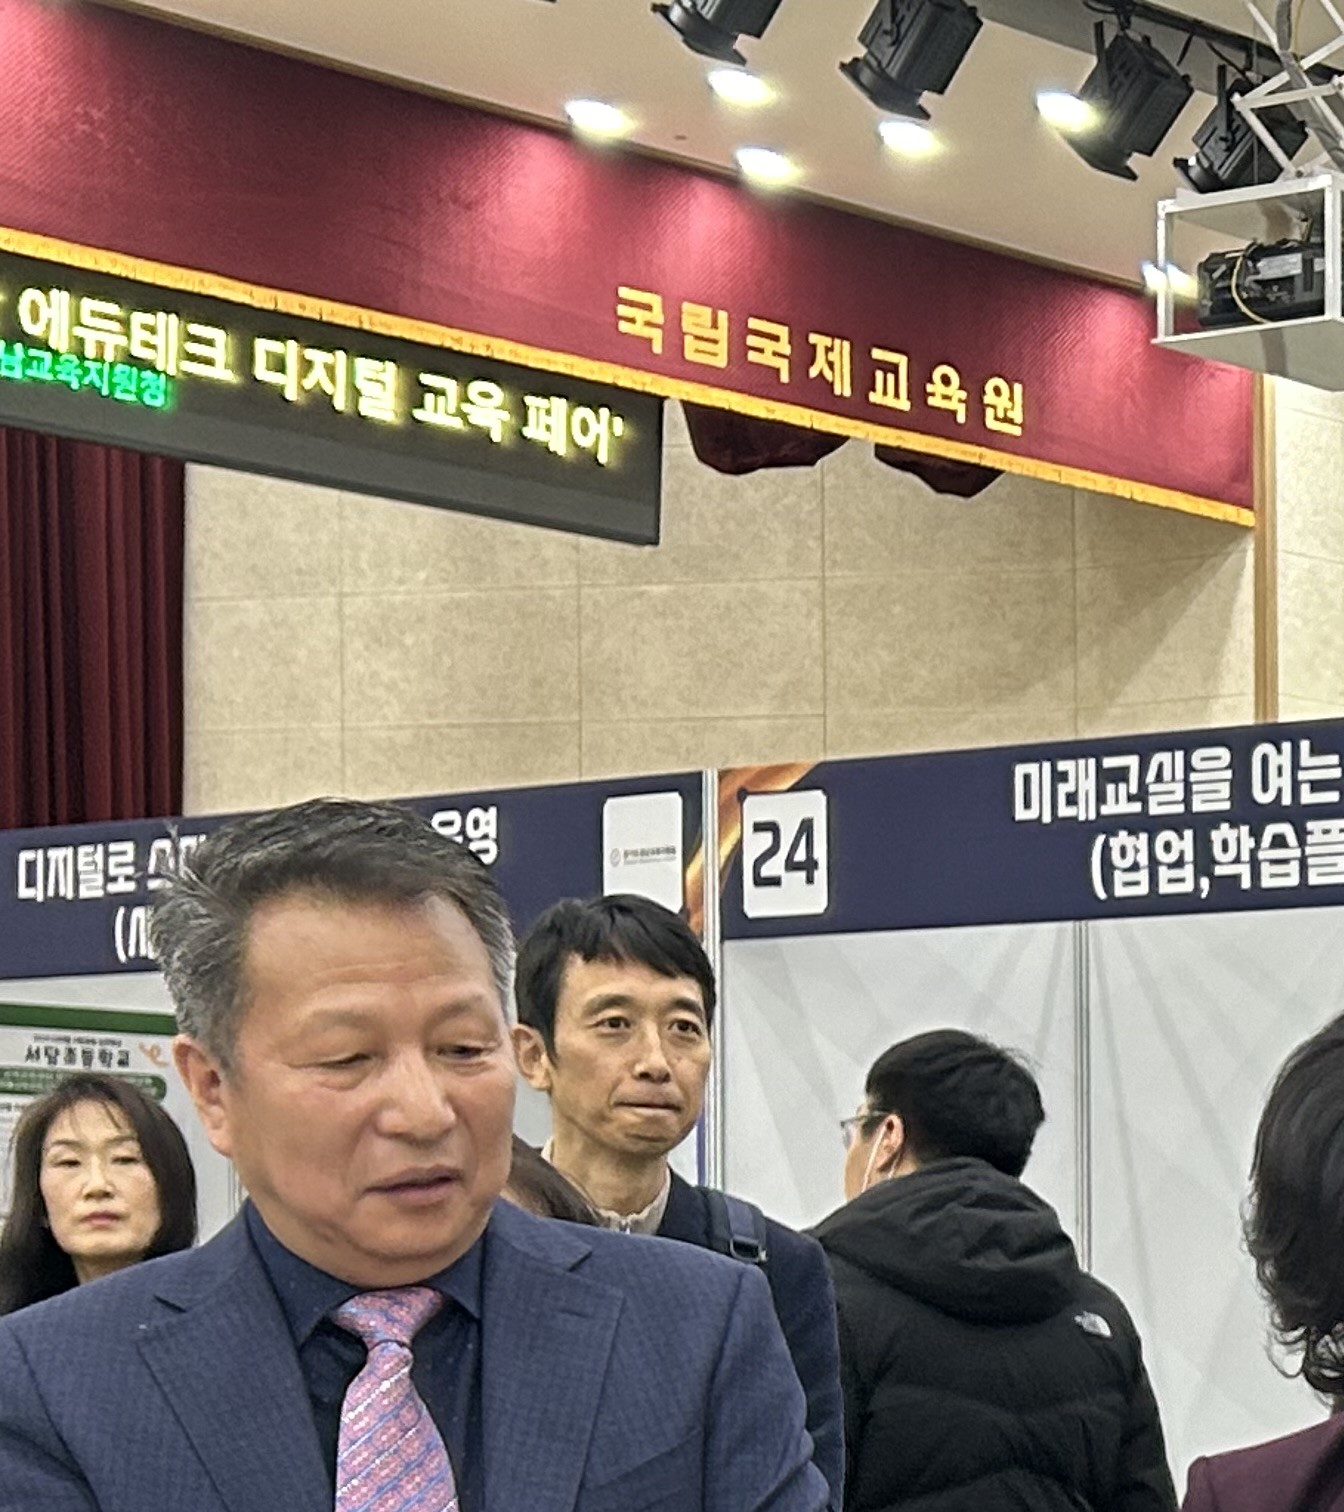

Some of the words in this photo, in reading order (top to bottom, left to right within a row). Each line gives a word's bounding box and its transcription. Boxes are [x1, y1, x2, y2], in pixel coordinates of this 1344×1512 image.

[17, 287, 240, 383] 에듀테크
[253, 336, 400, 424] 디지털
[412, 371, 511, 443] 교육
[616, 286, 1025, 437] 국립국제교육원
[1013, 745, 1234, 824] 미래교실을
[1251, 739, 1343, 807] 여는
[17, 840, 137, 903] 디지털로
[752, 817, 819, 889] 24
